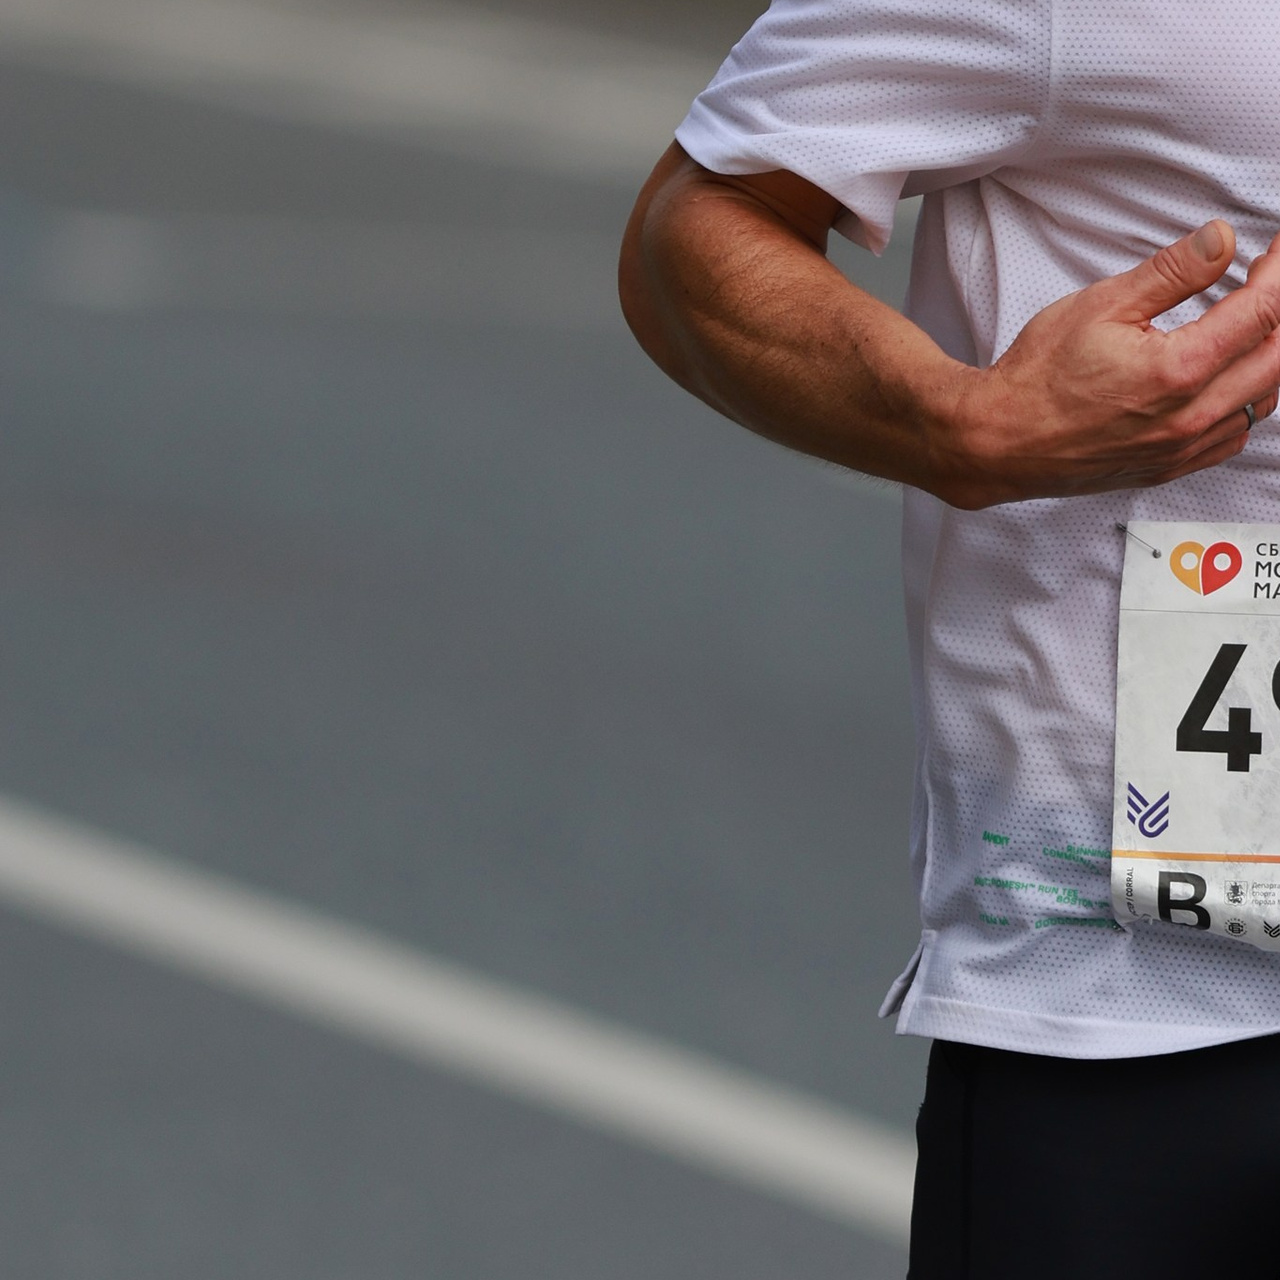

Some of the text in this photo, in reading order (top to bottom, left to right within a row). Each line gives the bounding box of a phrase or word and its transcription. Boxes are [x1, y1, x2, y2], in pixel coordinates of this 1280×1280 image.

[1038, 884, 1059, 895] RUN
[1062, 887, 1079, 898] TEE
[1125, 867, 1134, 897] CORRAL
